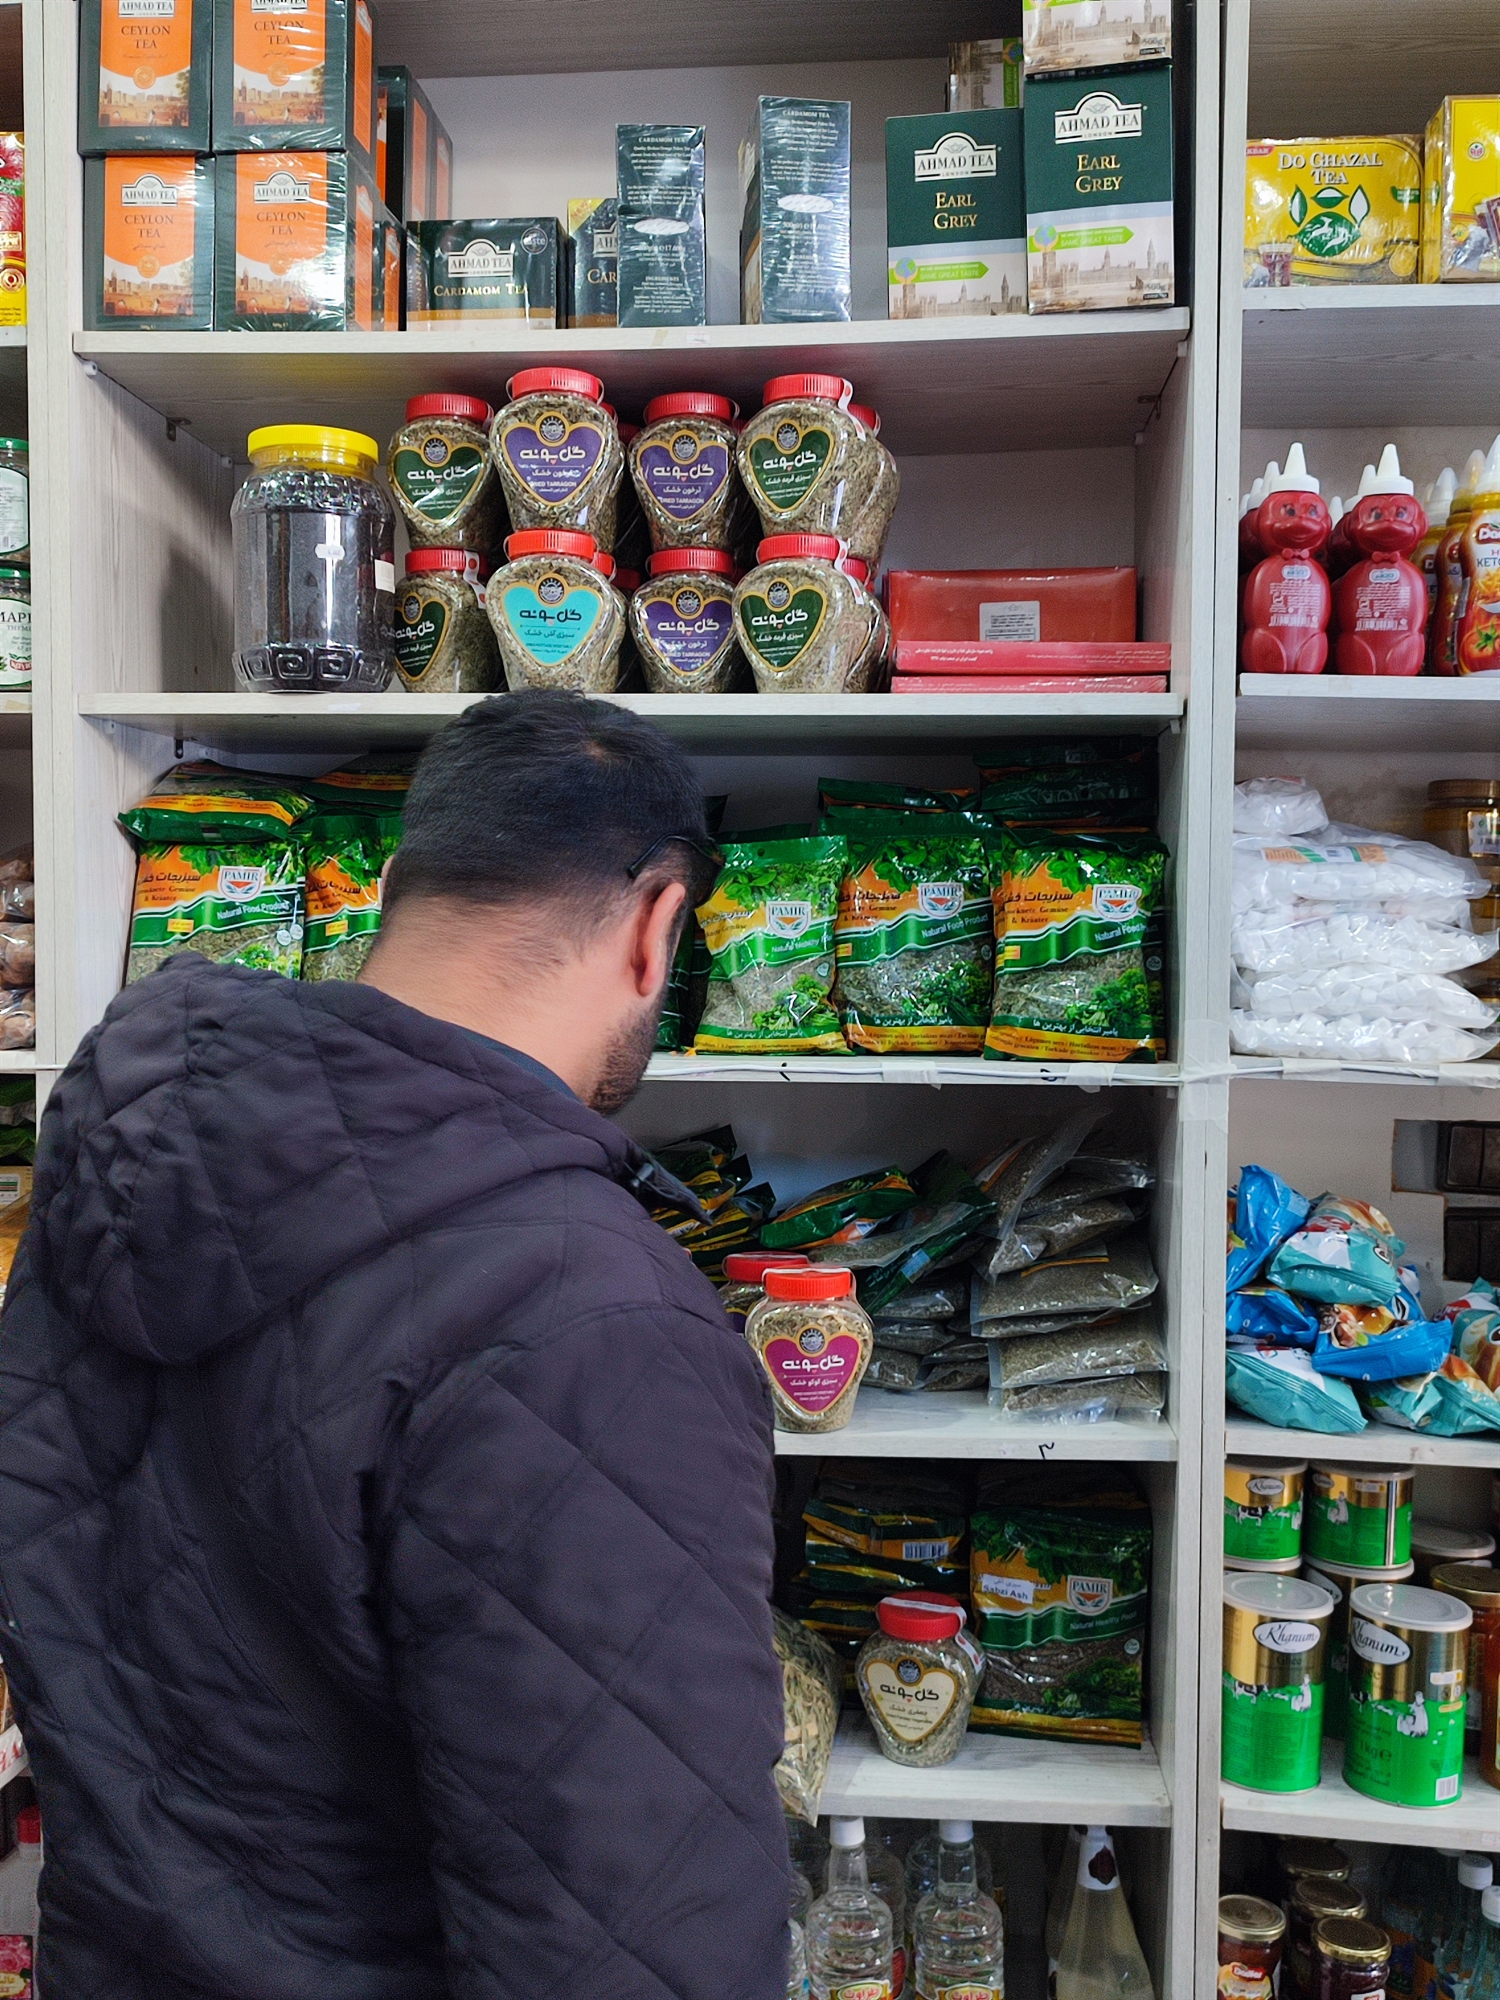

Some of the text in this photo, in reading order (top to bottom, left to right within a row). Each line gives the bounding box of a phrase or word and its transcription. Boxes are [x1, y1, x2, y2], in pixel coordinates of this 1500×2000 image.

[120, 1, 173, 11] AHMAD TEA
[121, 26, 171, 35] CEYLON
[254, 20, 304, 31] CEYLON
[136, 40, 158, 49] TEA
[268, 35, 291, 45] TEA
[1058, 114, 1139, 133] AHMAD TEA
[918, 154, 994, 171] AHMAD TEA
[1077, 154, 1121, 172] EARL
[1310, 169, 1349, 185] TEA
[1075, 175, 1123, 194] GREY
[124, 190, 176, 200] AHMAD TEA
[256, 187, 309, 197] AHMAD TEA
[935, 192, 977, 209] EARL
[124, 215, 174, 225] CEYLON
[256, 212, 307, 221] CEYLON
[934, 212, 978, 230] GREY
[138, 228, 161, 238] TEA
[270, 226, 293, 235] TEA
[1104, 234, 1124, 242] TASTE
[451, 259, 512, 269] AHMAD TEA
[939, 271, 959, 279] GREAT
[434, 282, 529, 297] CARDAMOM TEA
[560, 446, 586, 460] گل
[794, 450, 817, 467] گل
[690, 464, 715, 479] گل
[557, 609, 582, 623] گل
[785, 609, 808, 625] گل
[694, 618, 720, 633] گل
[557, 631, 575, 639] سبزی
[156, 872, 201, 883] سبزیجات
[224, 871, 259, 881] PAMIR
[924, 888, 958, 898] PAMIR
[1024, 892, 1074, 903] سبزیجات
[1099, 888, 1137, 899] PAMIR
[216, 907, 243, 920] Natural
[243, 904, 261, 914] Food
[772, 906, 806, 916] PAMIR
[921, 924, 947, 938] Natural
[1094, 928, 1121, 942] Natural
[874, 1017, 881, 1025] ها
[883, 1018, 906, 1027] بهترین
[1033, 1019, 1119, 1037] پامیر انتخابی از بهترین ها
[759, 1030, 764, 1038] از
[765, 1030, 788, 1039] انتخابی
[1044, 1046, 1069, 1054] Torkade
[1069, 1041, 1100, 1049] Hortalizas
[820, 1354, 845, 1371] گل
[1252, 1478, 1284, 1491] Khanum
[983, 1585, 1028, 1600] Sabzi Ash
[1073, 1581, 1107, 1594] PAMIR
[1070, 1621, 1094, 1630] Natural
[1095, 1616, 1120, 1627] Healthy
[1258, 1621, 1318, 1646] Khanum
[915, 1688, 939, 1702] گل
